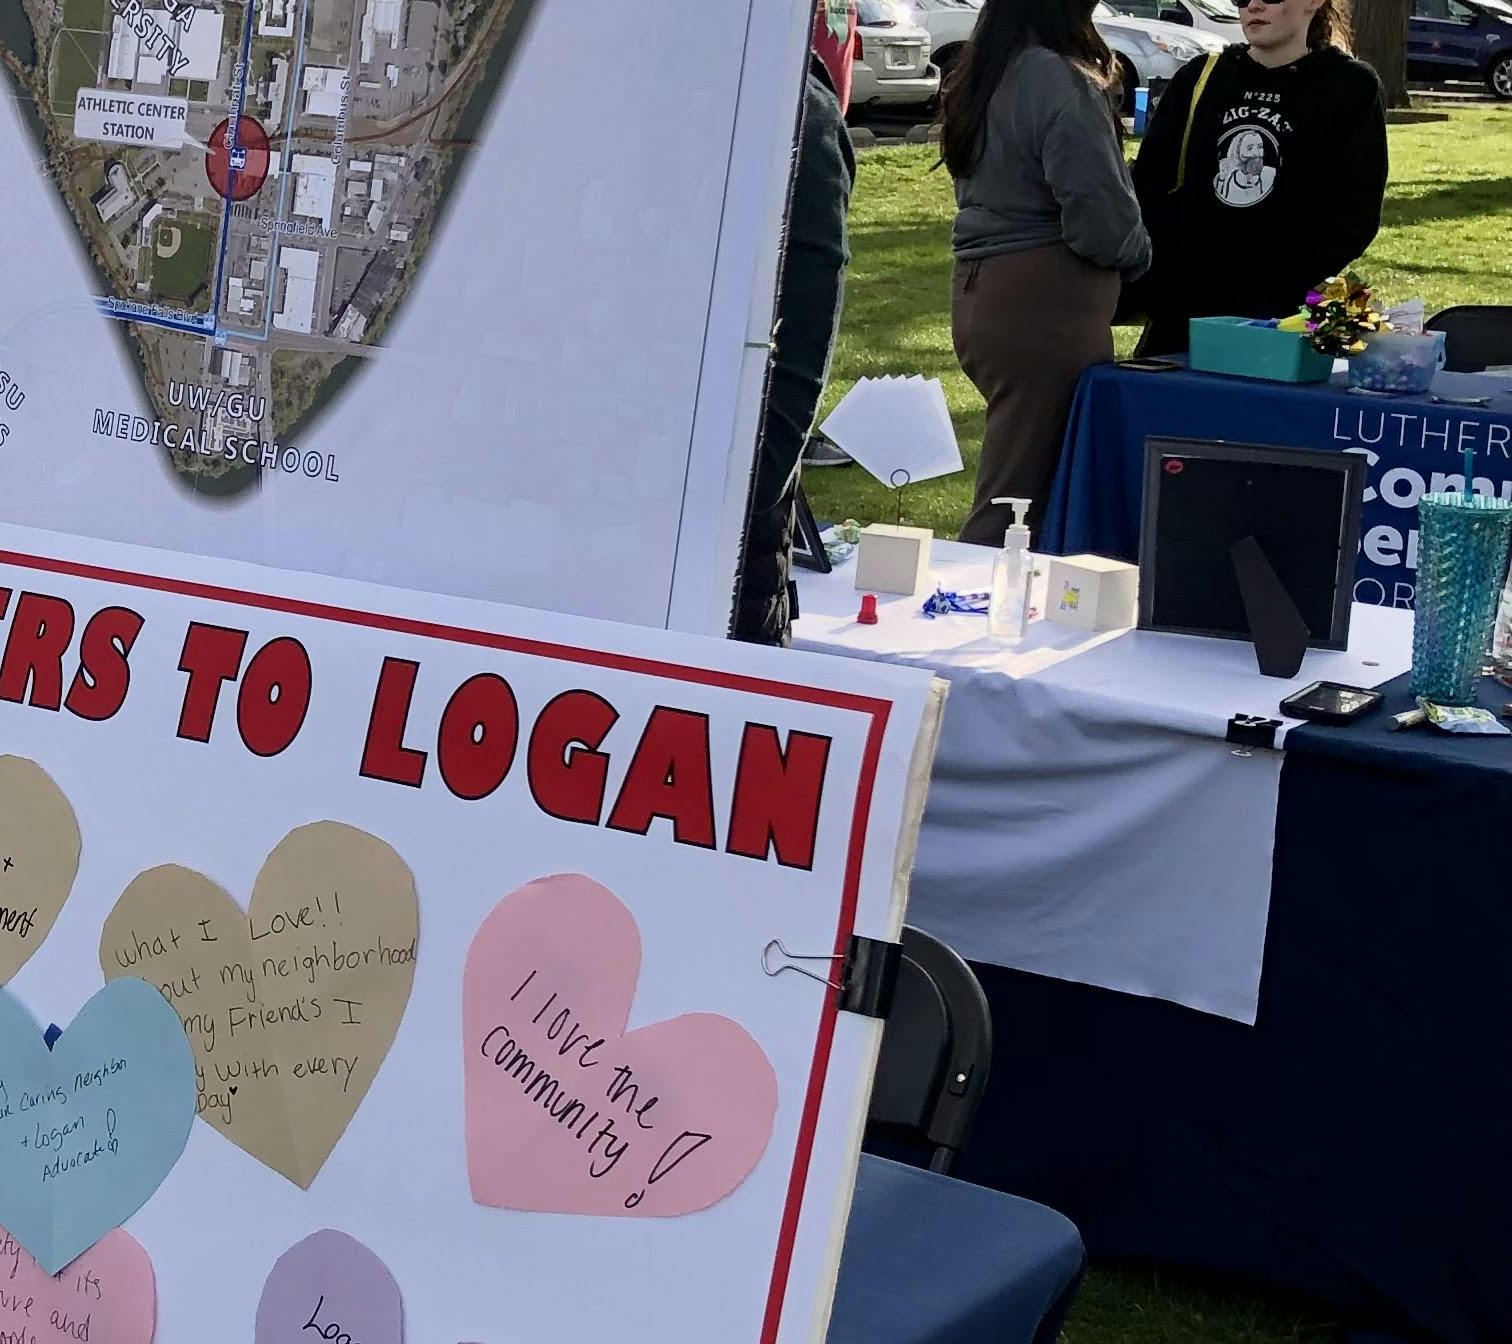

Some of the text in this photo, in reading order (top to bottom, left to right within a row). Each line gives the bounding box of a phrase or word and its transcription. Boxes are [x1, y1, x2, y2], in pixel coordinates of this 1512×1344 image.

[77, 96, 186, 121] ATHLETIC CENTER
[102, 121, 155, 142] STATION
[259, 217, 338, 240] Springfield Ave
[167, 379, 267, 423] UW/GU
[91, 408, 341, 483] MEDICAL SCHOOL
[176, 620, 313, 758] TO
[358, 655, 833, 872] LOGAN
[197, 918, 218, 943] I
[262, 935, 418, 984] neighborhood
[333, 998, 364, 1026] I
[510, 969, 660, 1130] I love the
[292, 1055, 360, 1094] every
[33, 1115, 86, 1153] Logan
[49, 1308, 92, 1343] and
